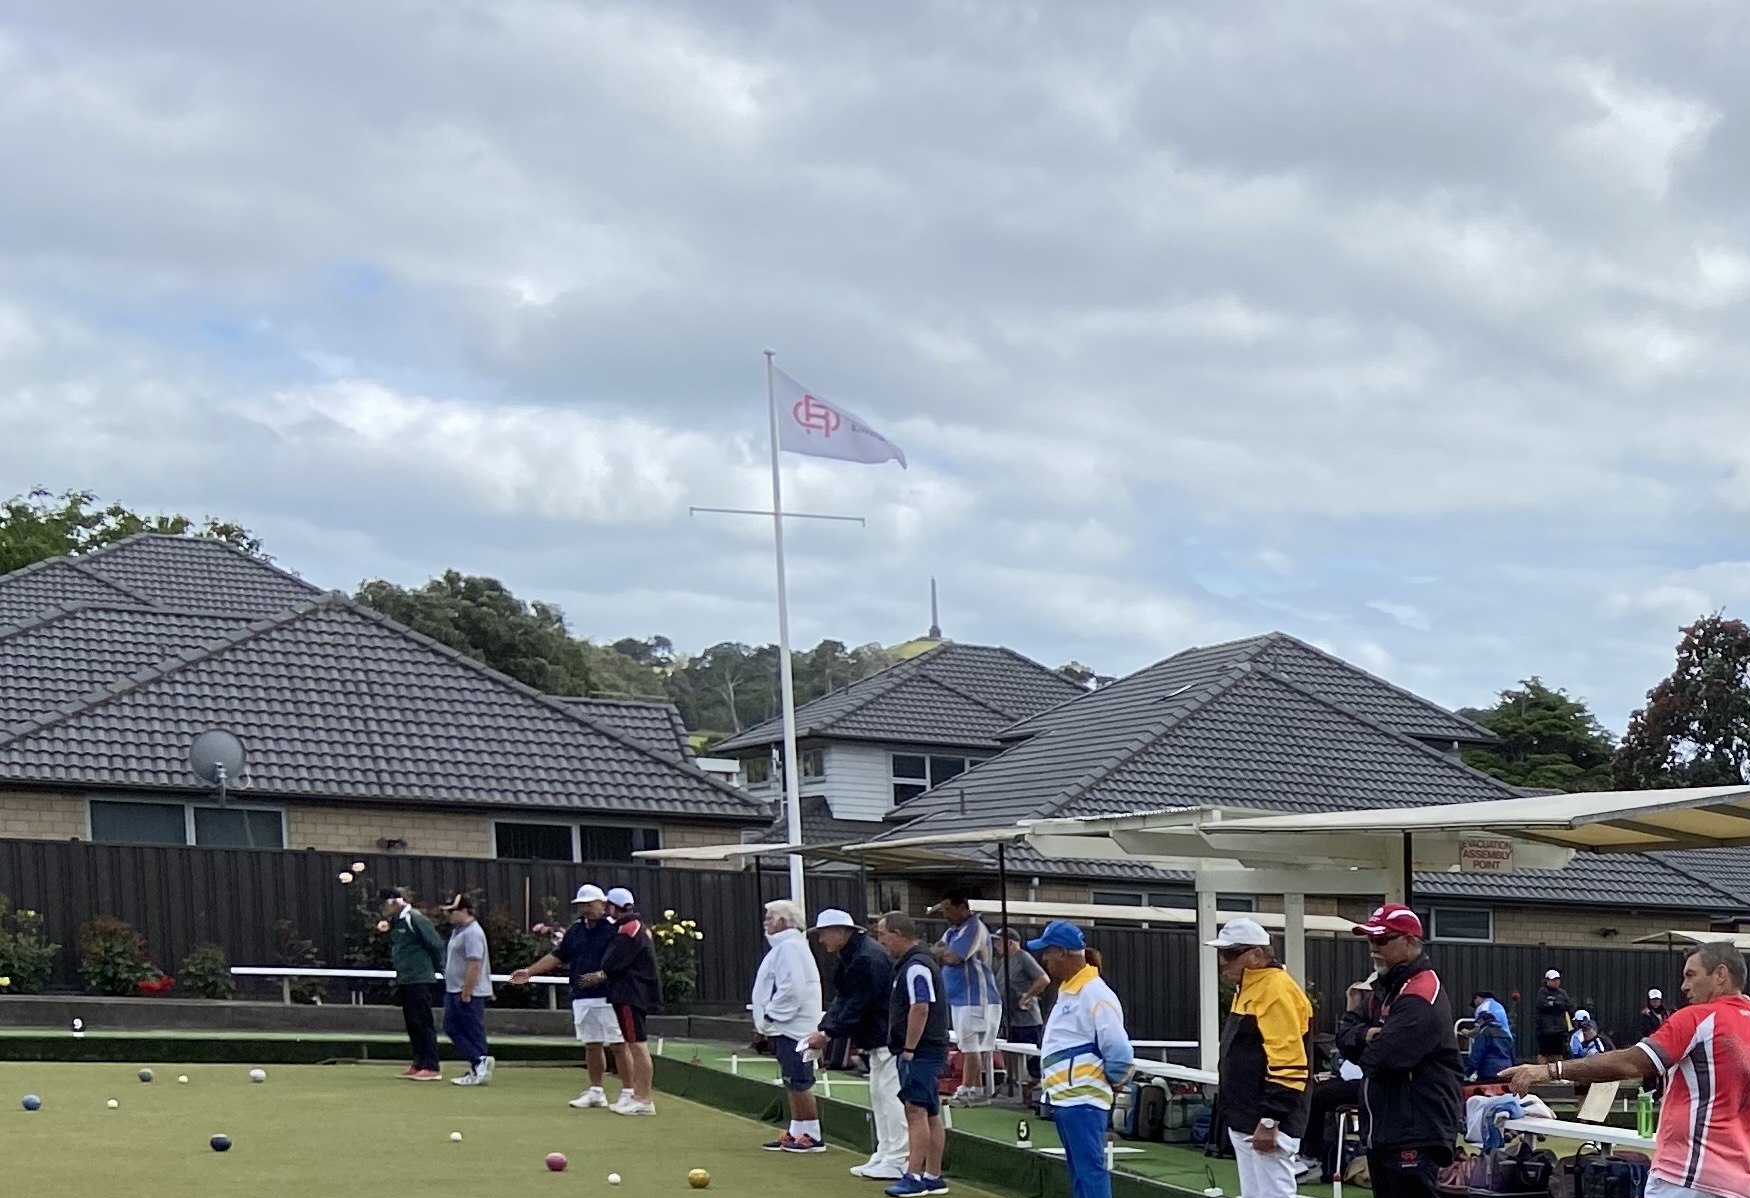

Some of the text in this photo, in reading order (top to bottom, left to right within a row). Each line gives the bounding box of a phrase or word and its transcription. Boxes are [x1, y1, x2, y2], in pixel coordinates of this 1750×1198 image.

[1462, 839, 1512, 849] EVACUATION
[1462, 848, 1513, 859] ASSEMBLY
[1472, 860, 1501, 870] POINT
[1019, 1121, 1028, 1138] 5
